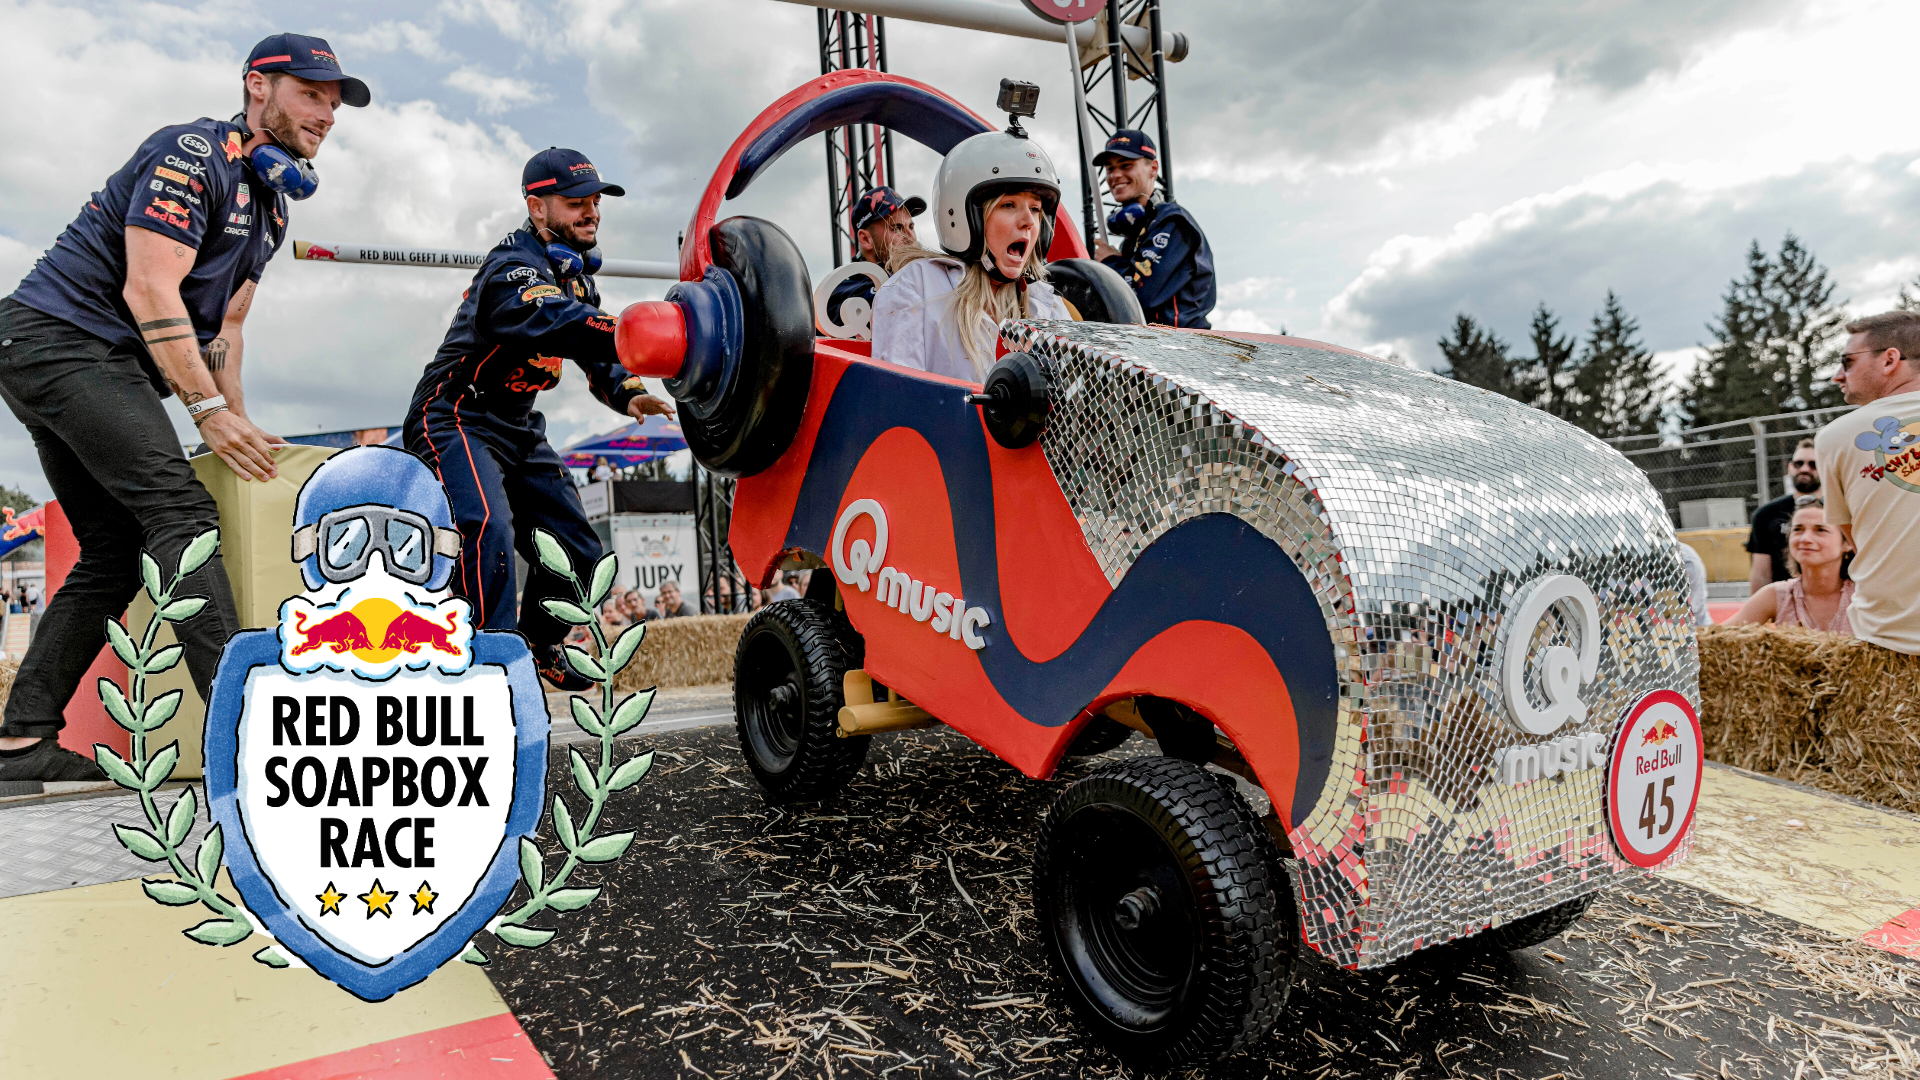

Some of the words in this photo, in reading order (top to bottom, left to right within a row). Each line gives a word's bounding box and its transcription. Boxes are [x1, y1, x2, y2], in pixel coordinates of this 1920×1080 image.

[183, 136, 208, 153] Esso
[164, 155, 201, 175] Claro
[165, 185, 185, 198] Cash
[185, 193, 201, 205] App
[144, 206, 169, 221] Red
[168, 212, 191, 230] Bull
[360, 249, 380, 261] RED
[383, 250, 407, 262] BULL
[409, 252, 437, 263] GEEFT
[440, 253, 450, 264] JE
[586, 316, 603, 329] Red
[1871, 452, 1910, 482] ITCHY
[632, 564, 684, 591] JURY
[1503, 574, 1602, 736] Q
[1499, 731, 1608, 786] music
[1636, 752, 1659, 776] Red
[1660, 743, 1682, 769] Bull
[1638, 775, 1676, 840] 45
